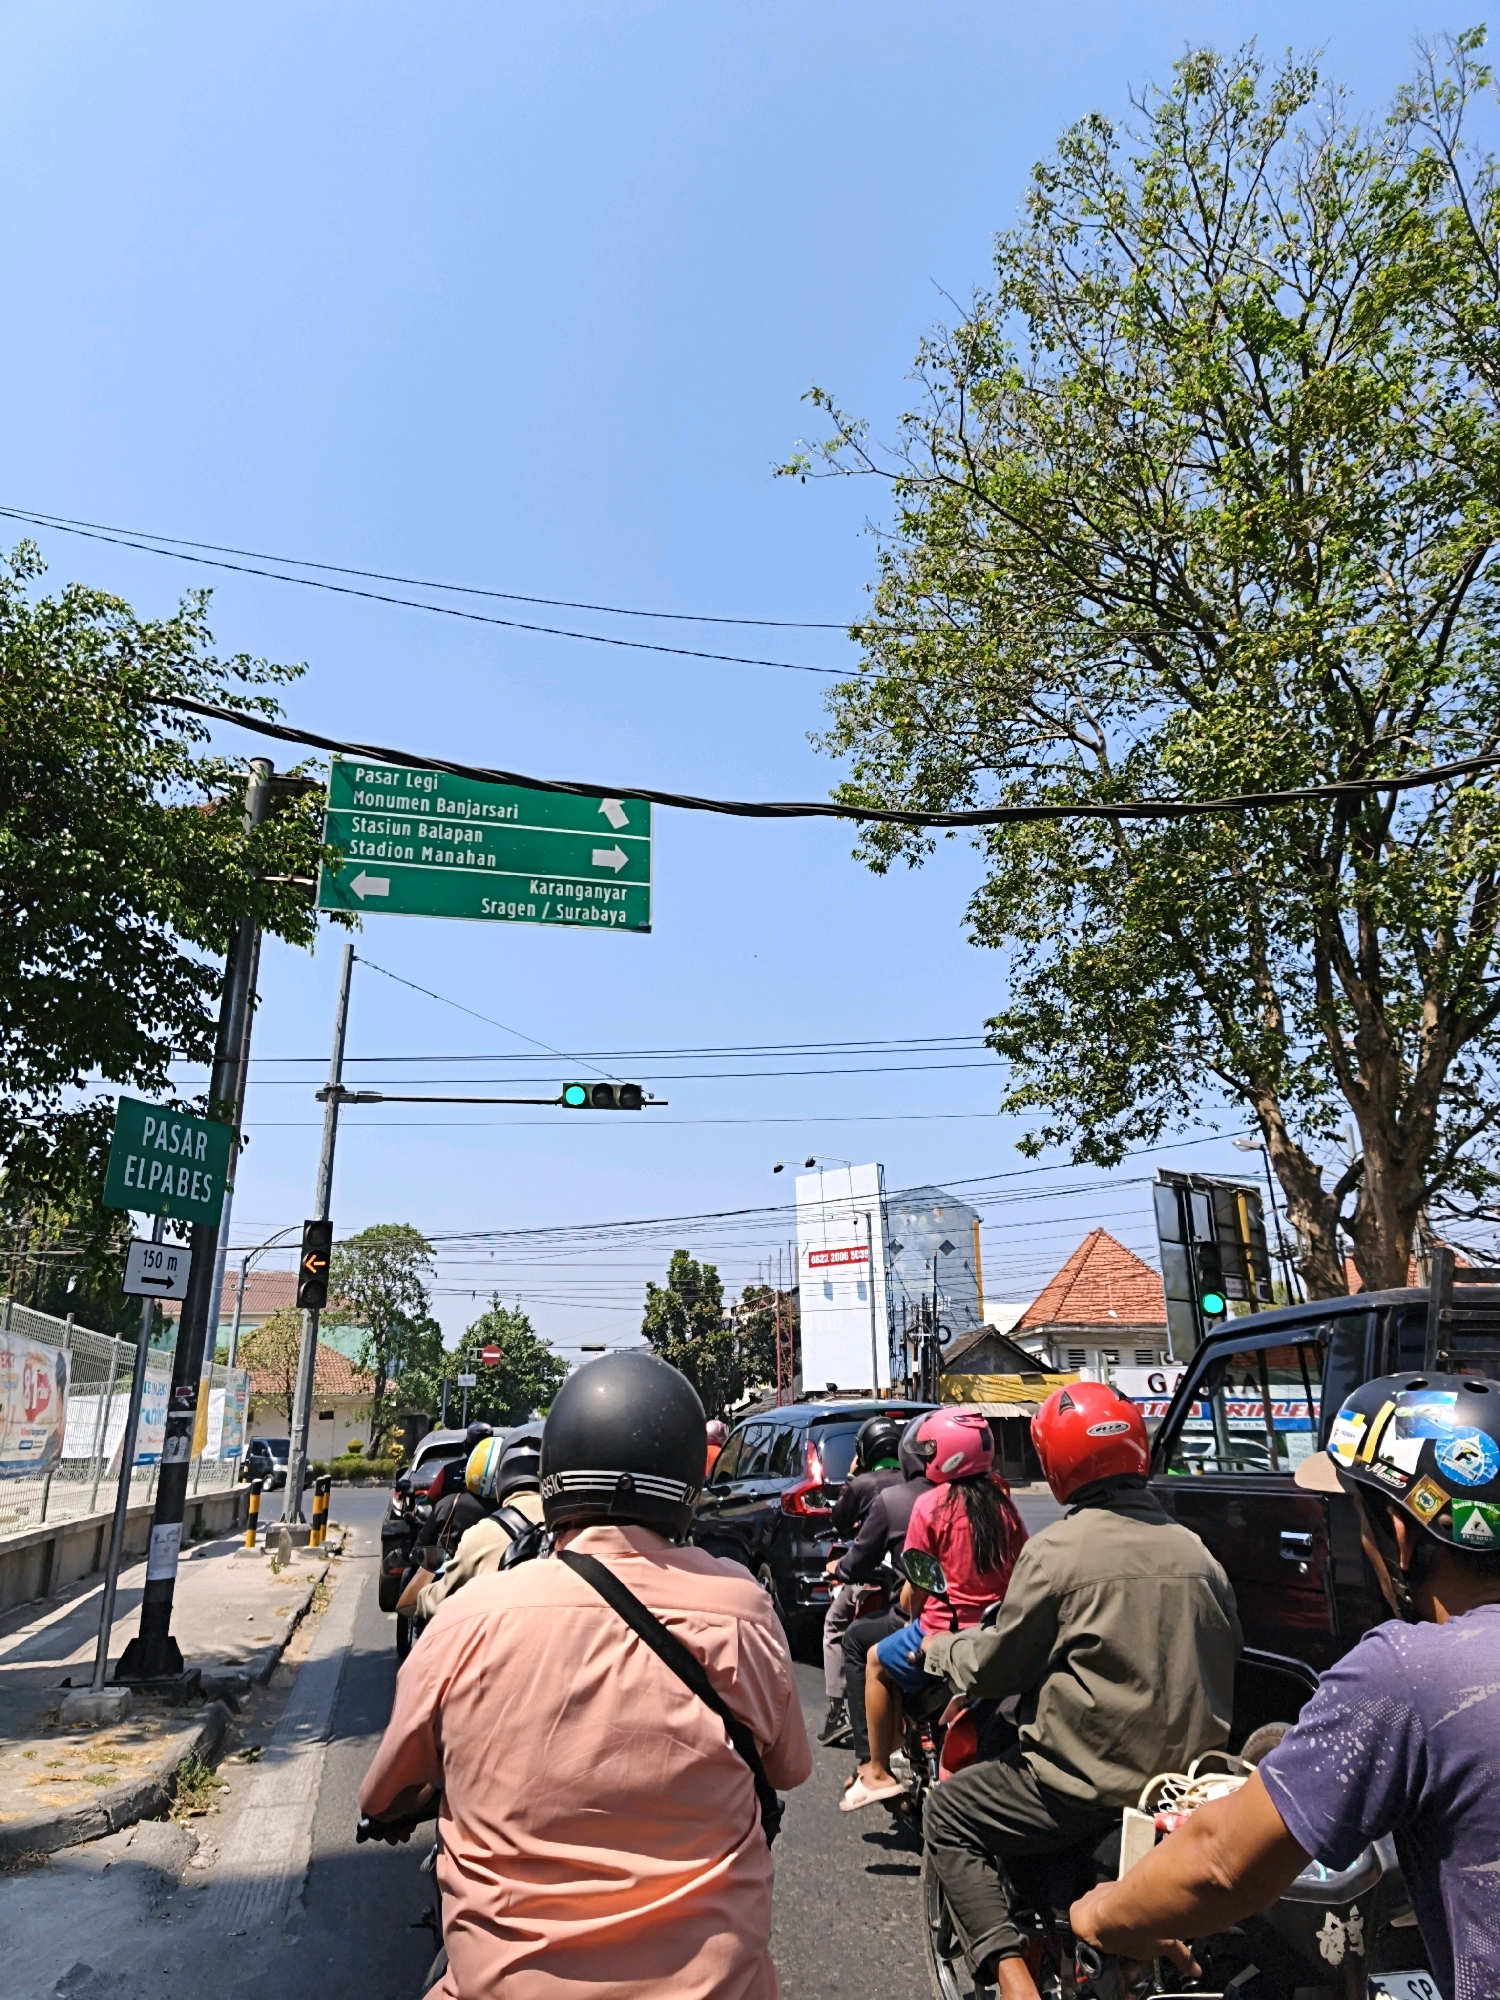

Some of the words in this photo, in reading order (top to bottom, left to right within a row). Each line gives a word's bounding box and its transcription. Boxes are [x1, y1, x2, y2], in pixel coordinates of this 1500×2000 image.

[355, 767, 400, 786] Pasar
[406, 773, 438, 793] Legi
[353, 791, 431, 811] Monumen
[436, 797, 519, 819] Banjarsari
[351, 817, 411, 836] Stasiun
[418, 824, 483, 844] Balapan
[350, 840, 414, 860] Stadion
[422, 847, 497, 868] Manahan
[530, 879, 628, 904] Karanganyar
[481, 898, 536, 919] Sragen
[556, 903, 627, 926] Surabaya
[142, 1116, 208, 1162] PASAR
[124, 1155, 213, 1203] ELPABES
[143, 1249, 163, 1269] 150
[167, 1256, 178, 1272] m
